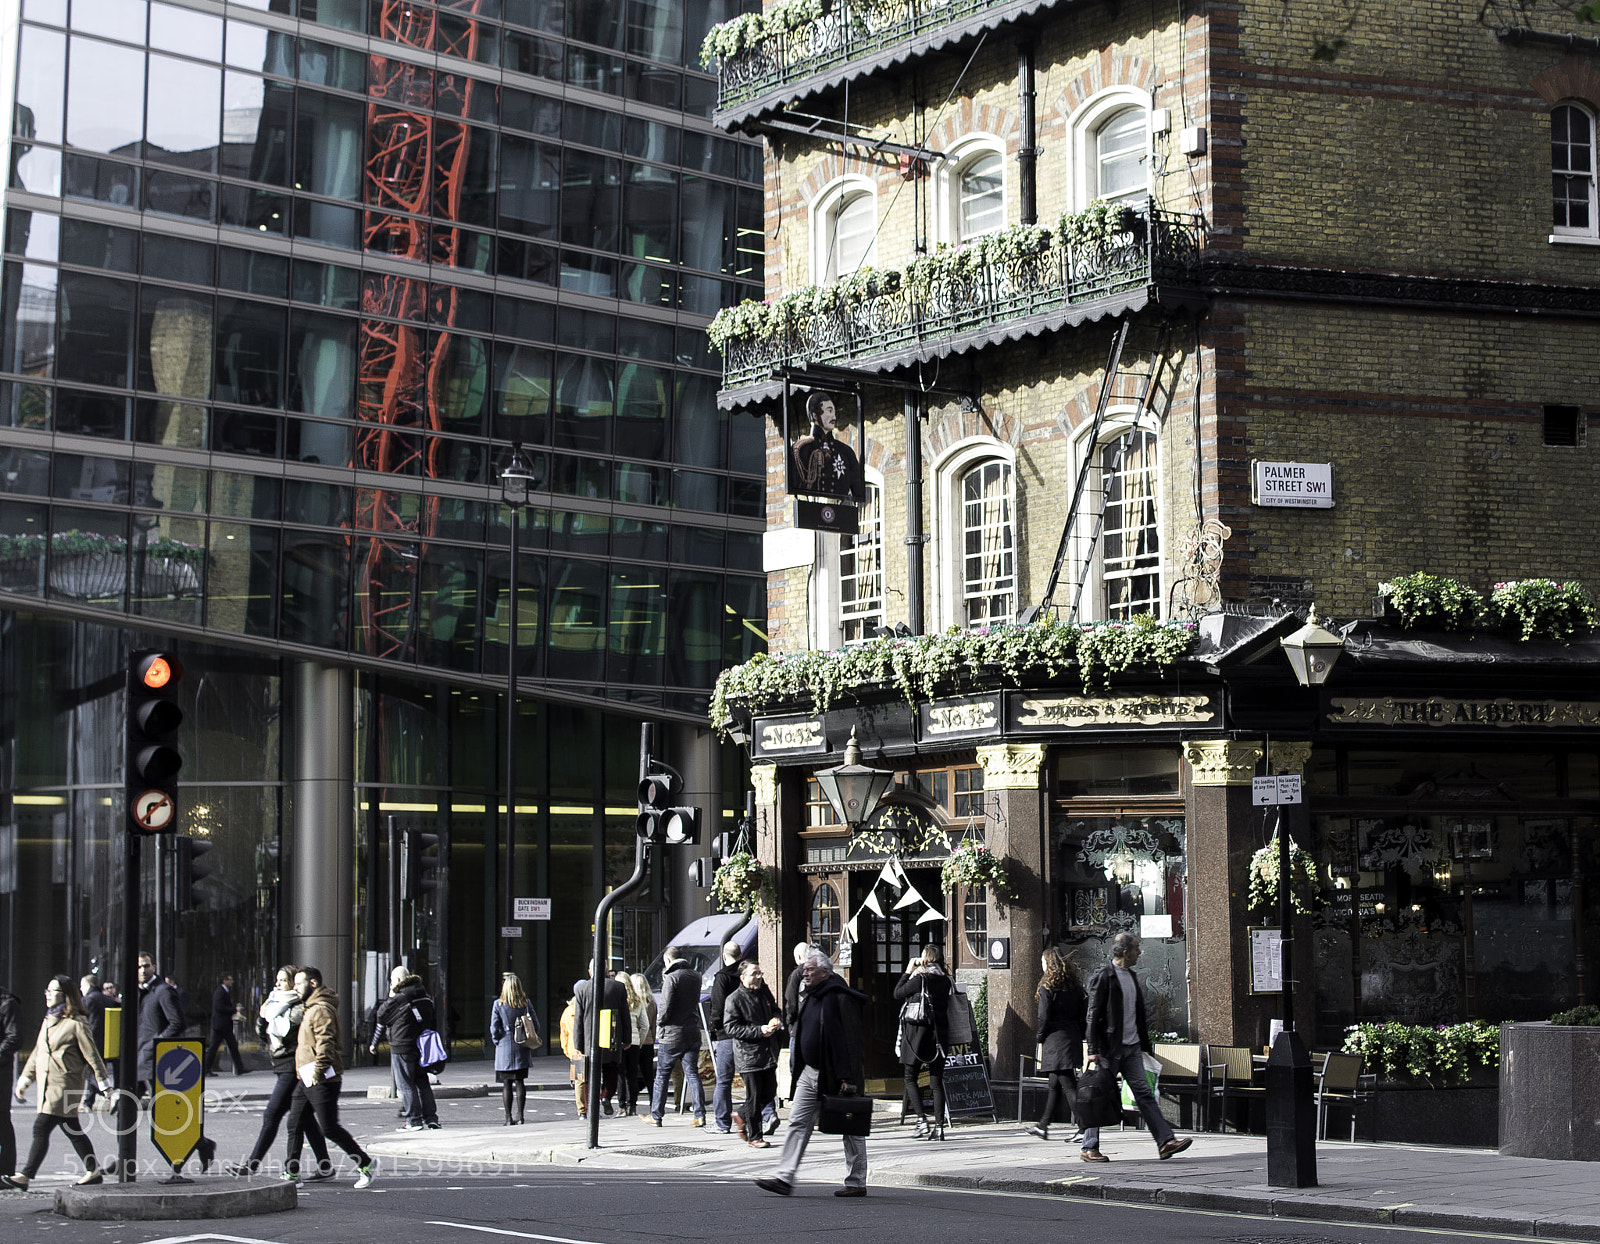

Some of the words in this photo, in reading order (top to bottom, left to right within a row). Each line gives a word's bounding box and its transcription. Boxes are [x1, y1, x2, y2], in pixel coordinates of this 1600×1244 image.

[1264, 466, 1306, 479] PALMER
[1265, 480, 1303, 492] STREET
[1306, 481, 1326, 493] SW1
[1042, 704, 1100, 718] WINES
[1104, 705, 1116, 716] &
[1120, 702, 1191, 716] SPIRITS
[1394, 702, 1444, 721] THE
[1454, 703, 1549, 722] ALBERT
